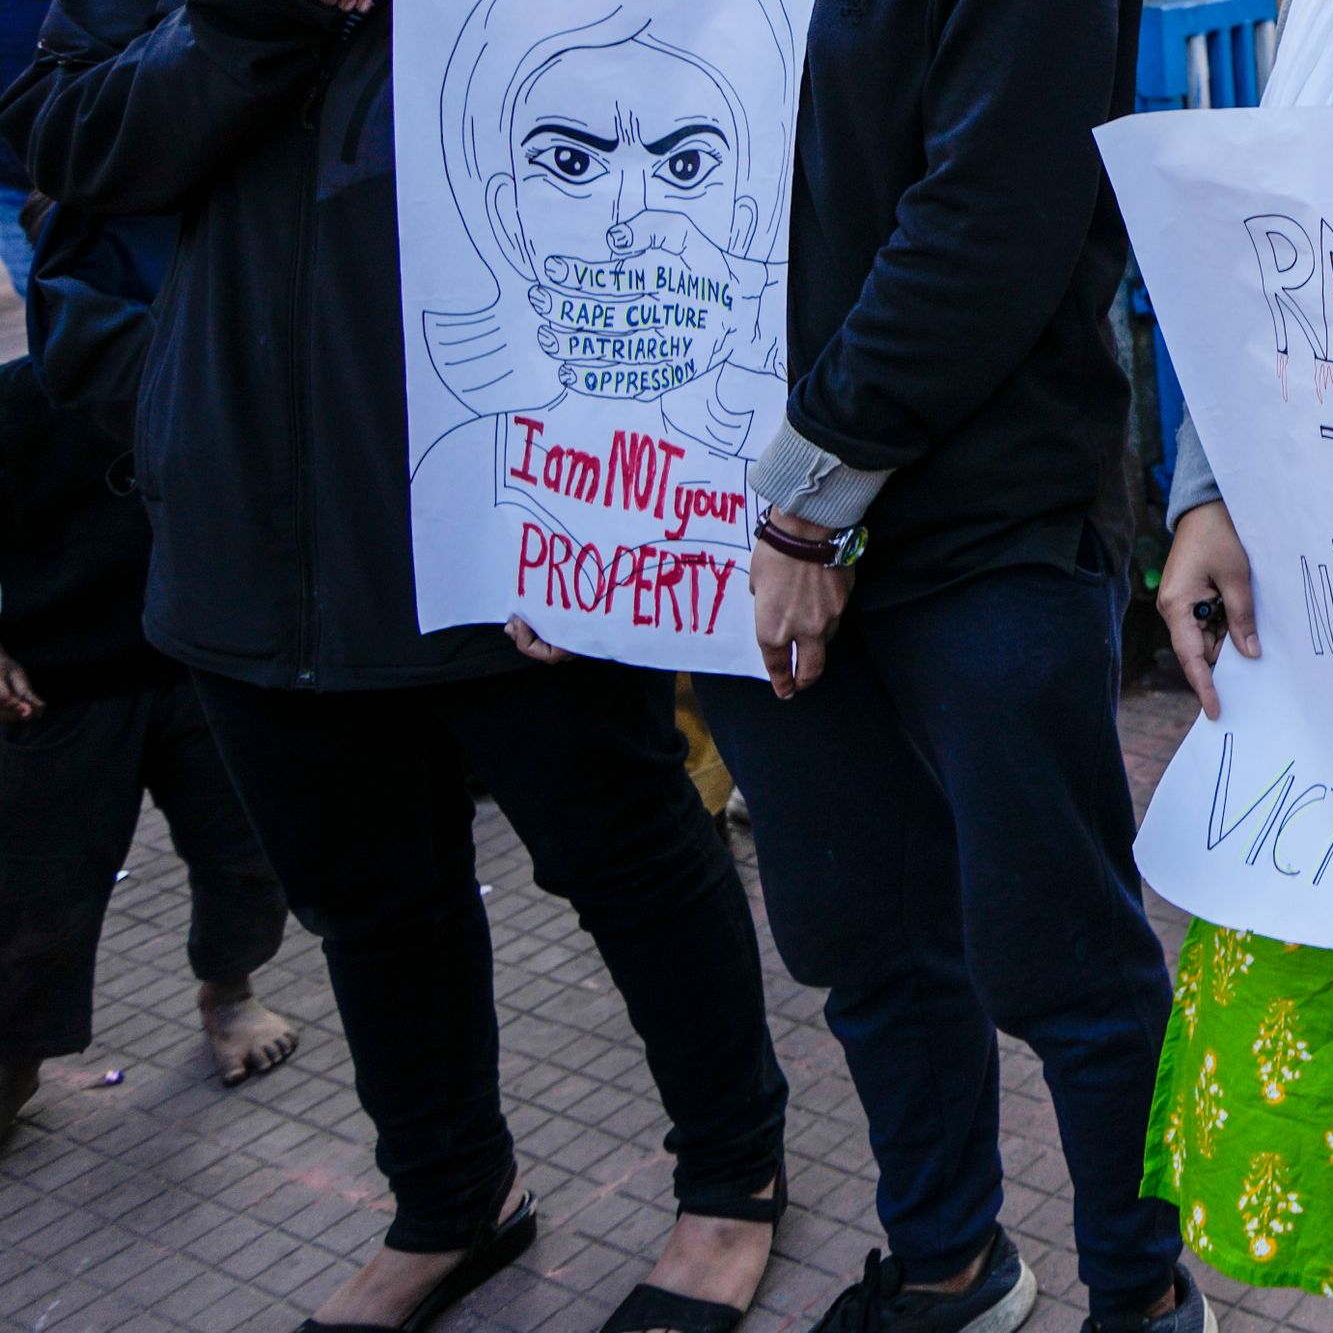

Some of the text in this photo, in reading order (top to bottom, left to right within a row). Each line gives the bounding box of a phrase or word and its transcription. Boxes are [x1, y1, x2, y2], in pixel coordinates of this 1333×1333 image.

[574, 258, 733, 310] VICTIM BLAMING
[560, 300, 708, 329] RAPE CULTURE
[569, 335, 693, 361] PATRIARCHY
[584, 358, 695, 394] OPPRESSION
[510, 415, 745, 540] I am NOT your
[517, 522, 736, 635] PROPERTY
